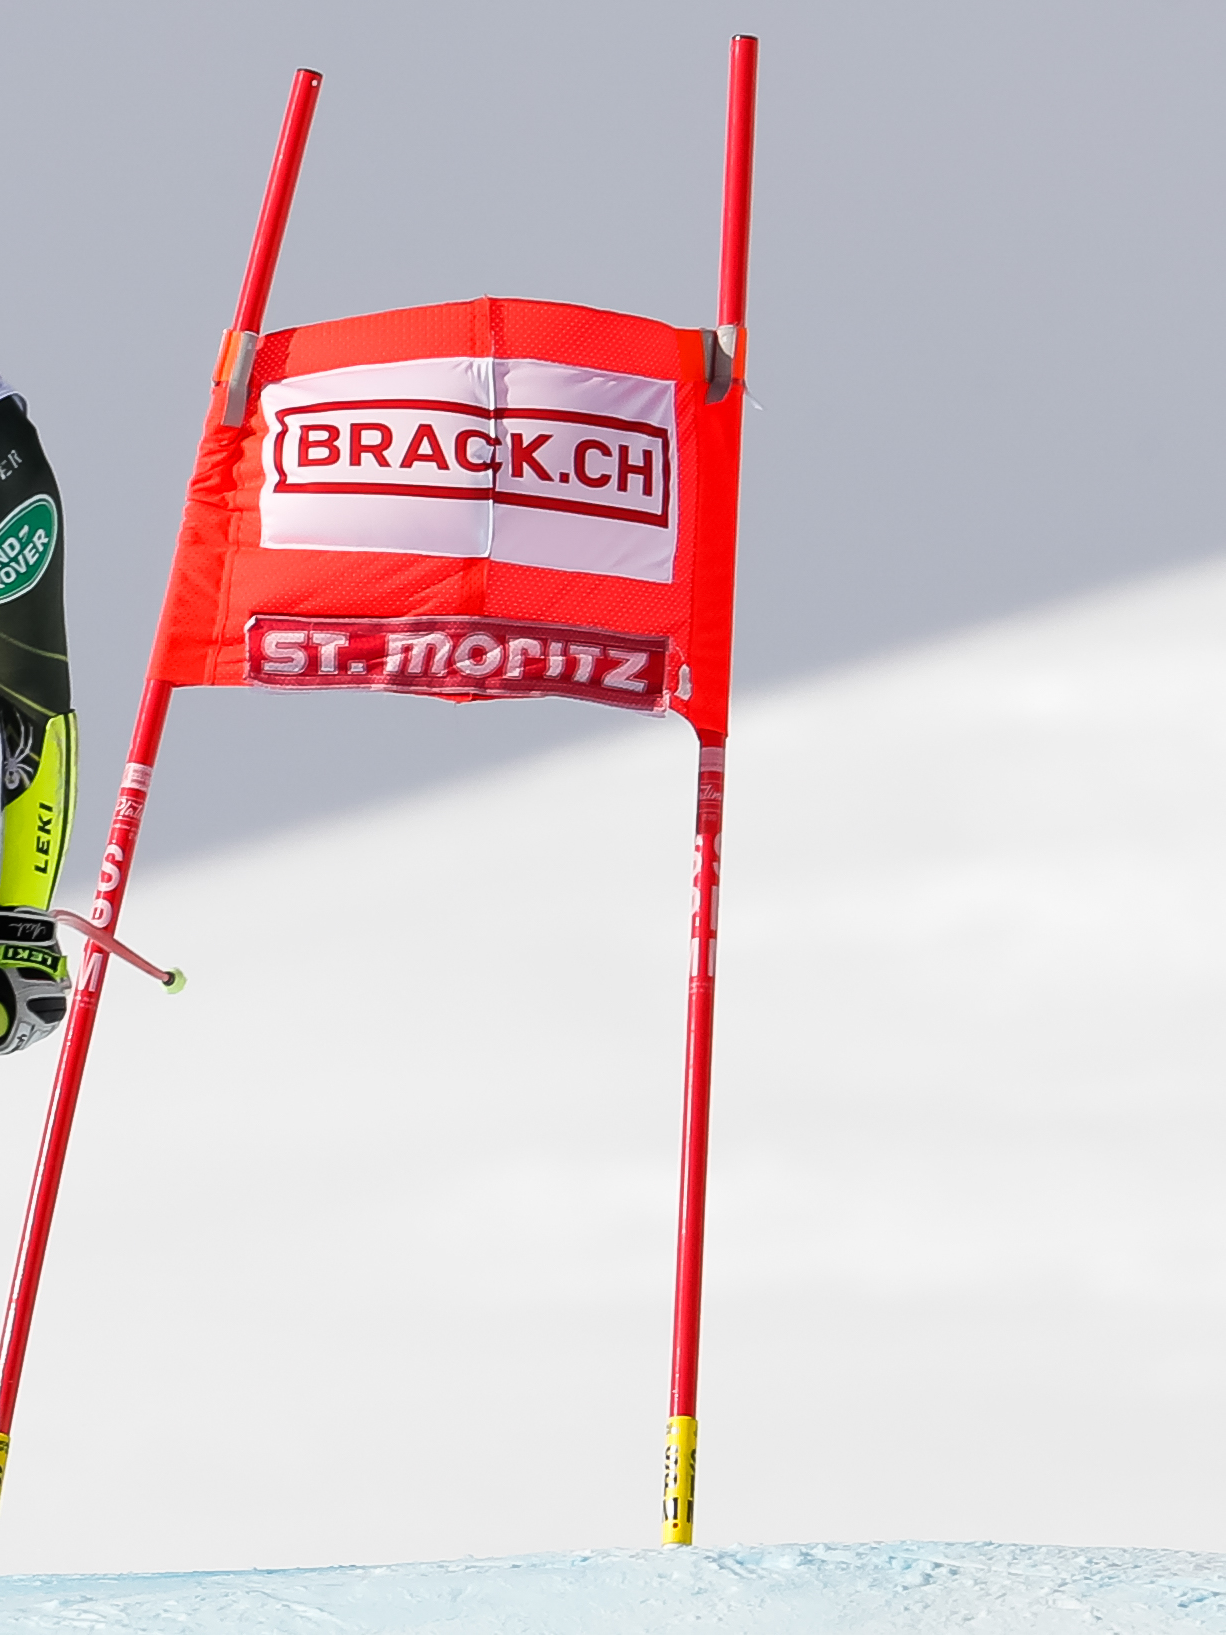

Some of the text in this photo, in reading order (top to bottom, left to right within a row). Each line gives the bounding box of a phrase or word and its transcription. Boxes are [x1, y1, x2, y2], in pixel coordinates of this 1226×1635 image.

[296, 421, 655, 499] BRACK.CH
[260, 630, 367, 675] ST.
[33, 802, 54, 875] LEKI
[6, 947, 53, 966] LEKI
